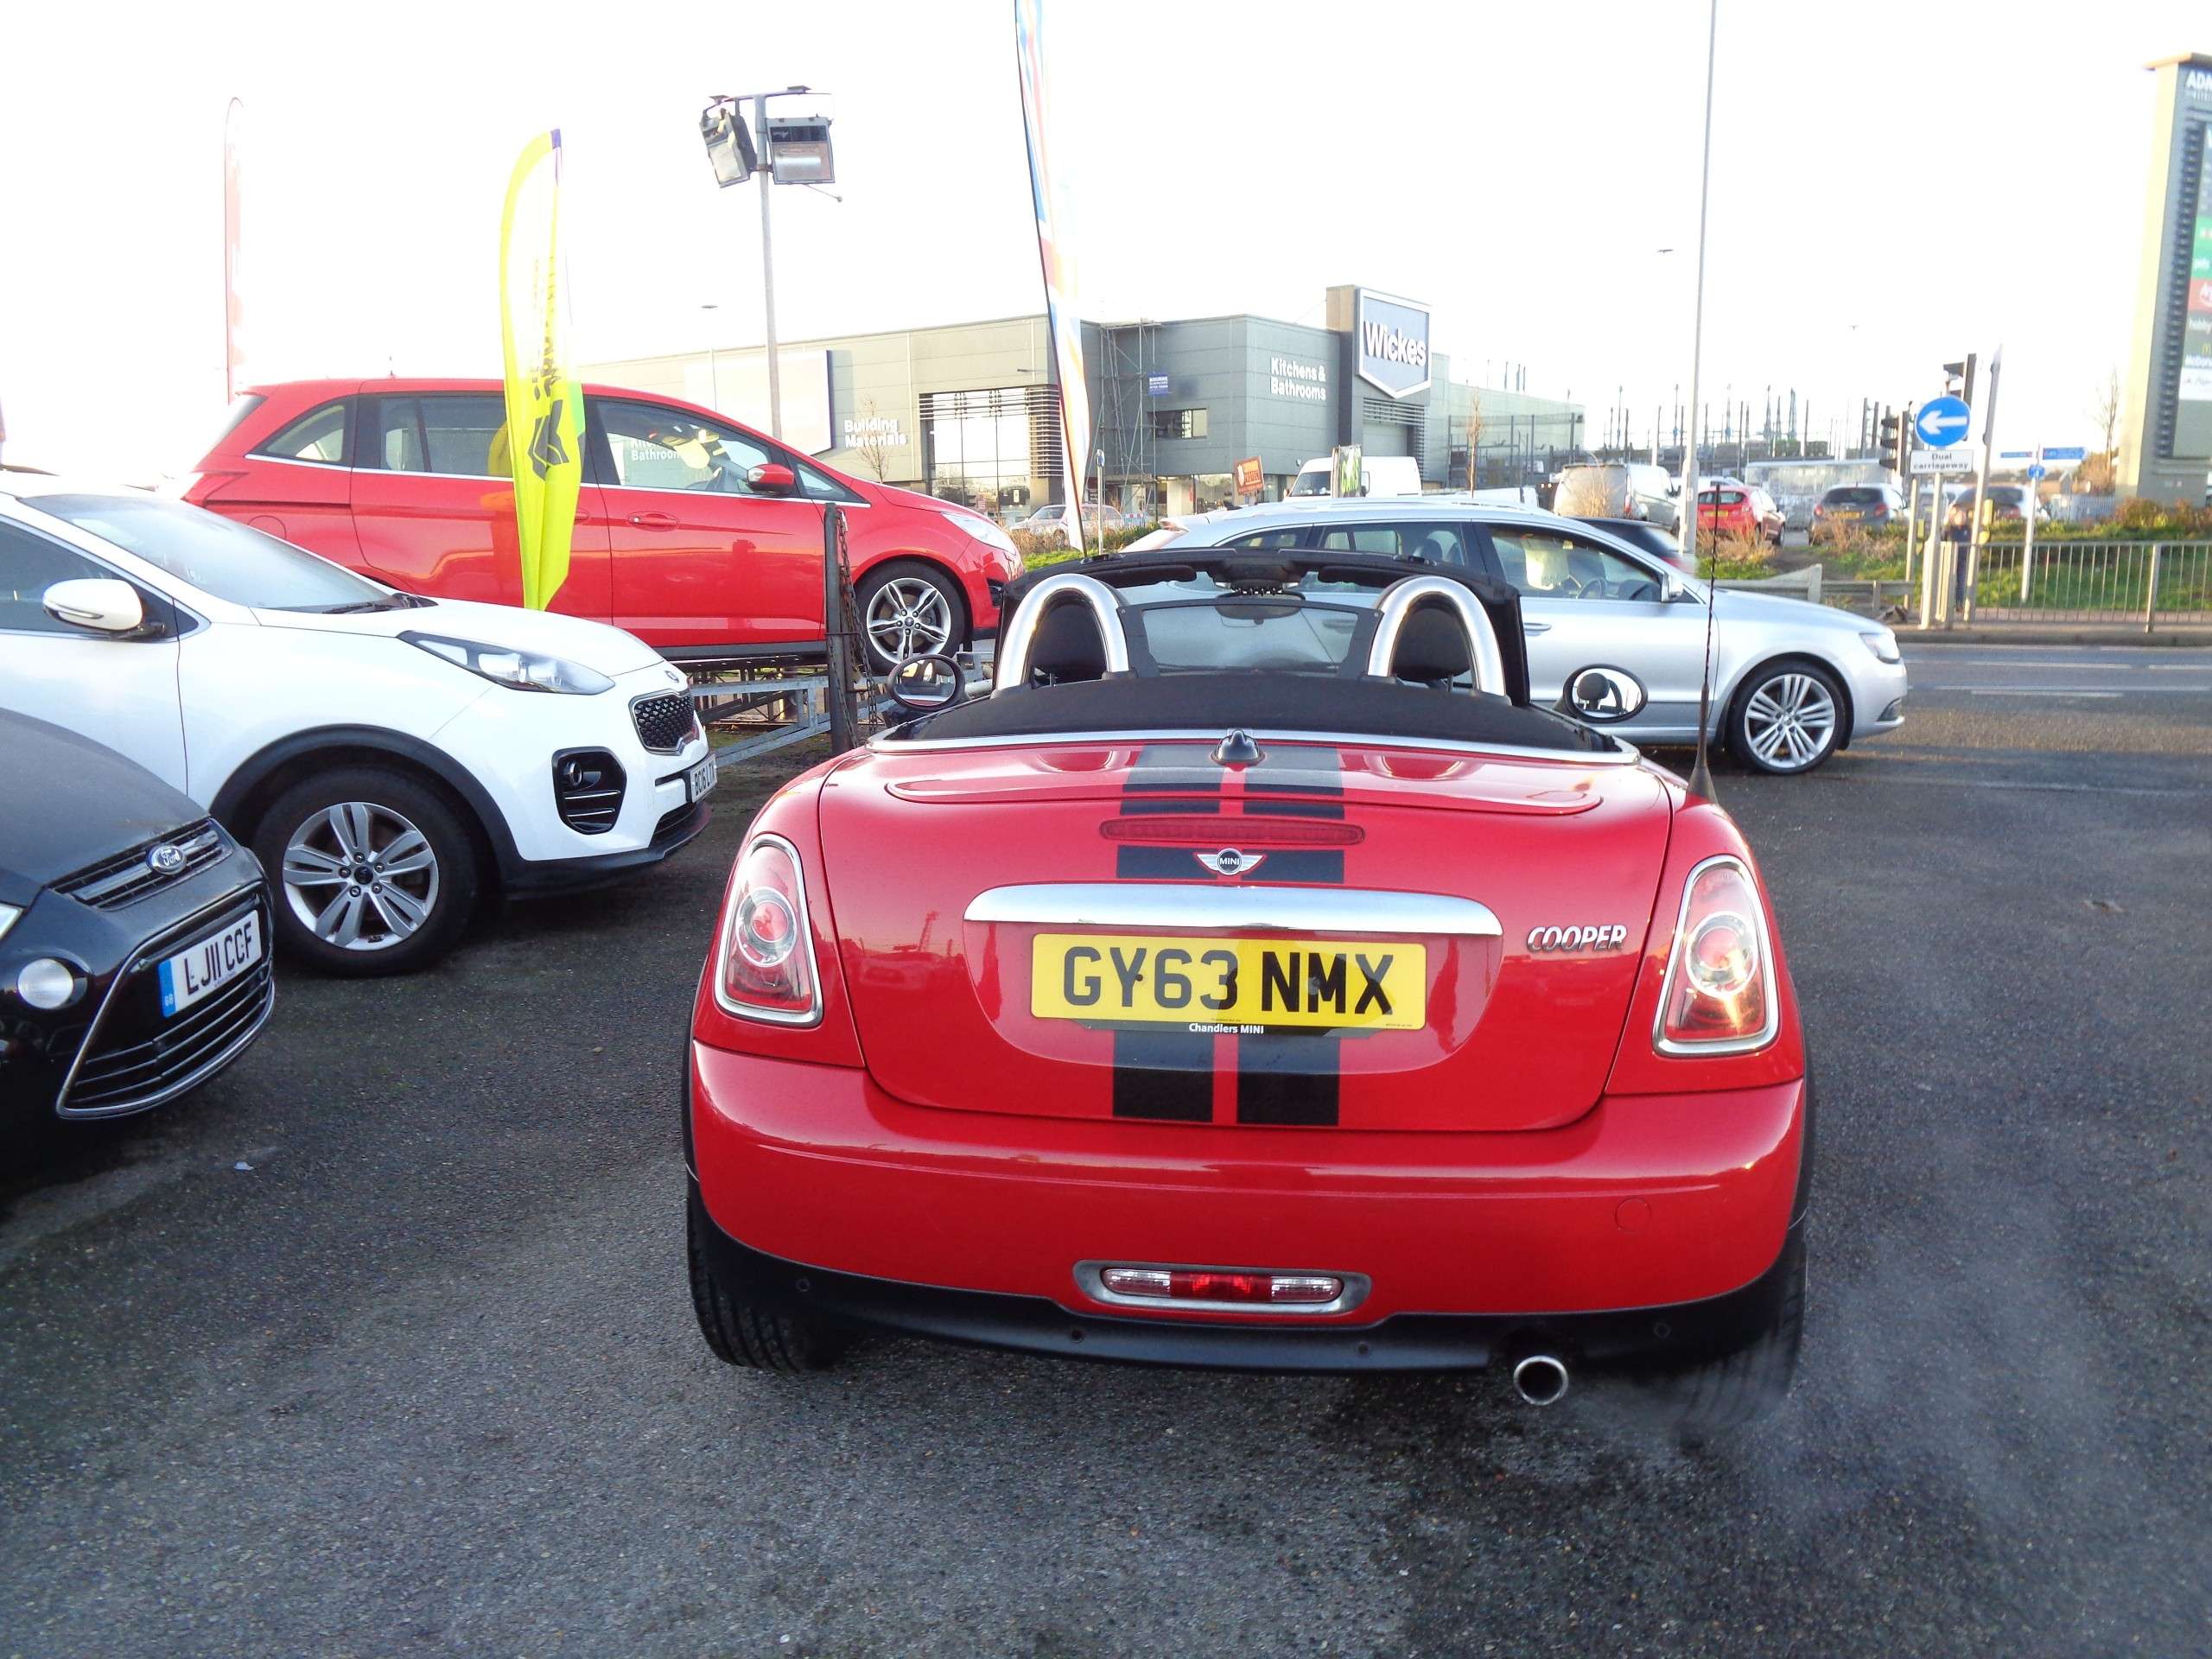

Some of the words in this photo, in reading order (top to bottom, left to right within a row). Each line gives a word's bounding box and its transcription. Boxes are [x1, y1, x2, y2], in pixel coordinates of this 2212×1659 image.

[1363, 321, 1427, 367] Wickes
[1271, 357, 1318, 381] Kitchens
[1318, 365, 1326, 382] &
[1271, 376, 1326, 401] Bathrooms
[844, 418, 899, 433] Building
[845, 431, 908, 448] Materials
[161, 849, 181, 867] Ford
[1527, 925, 1628, 952] COOPER
[183, 942, 222, 996] LJ11
[224, 920, 252, 971] CCF
[1064, 945, 1238, 1010] GY63
[1262, 951, 1394, 1015] NMX
[1188, 1022, 1238, 1033] Chandlers
[1240, 1025, 1264, 1034] MINI
